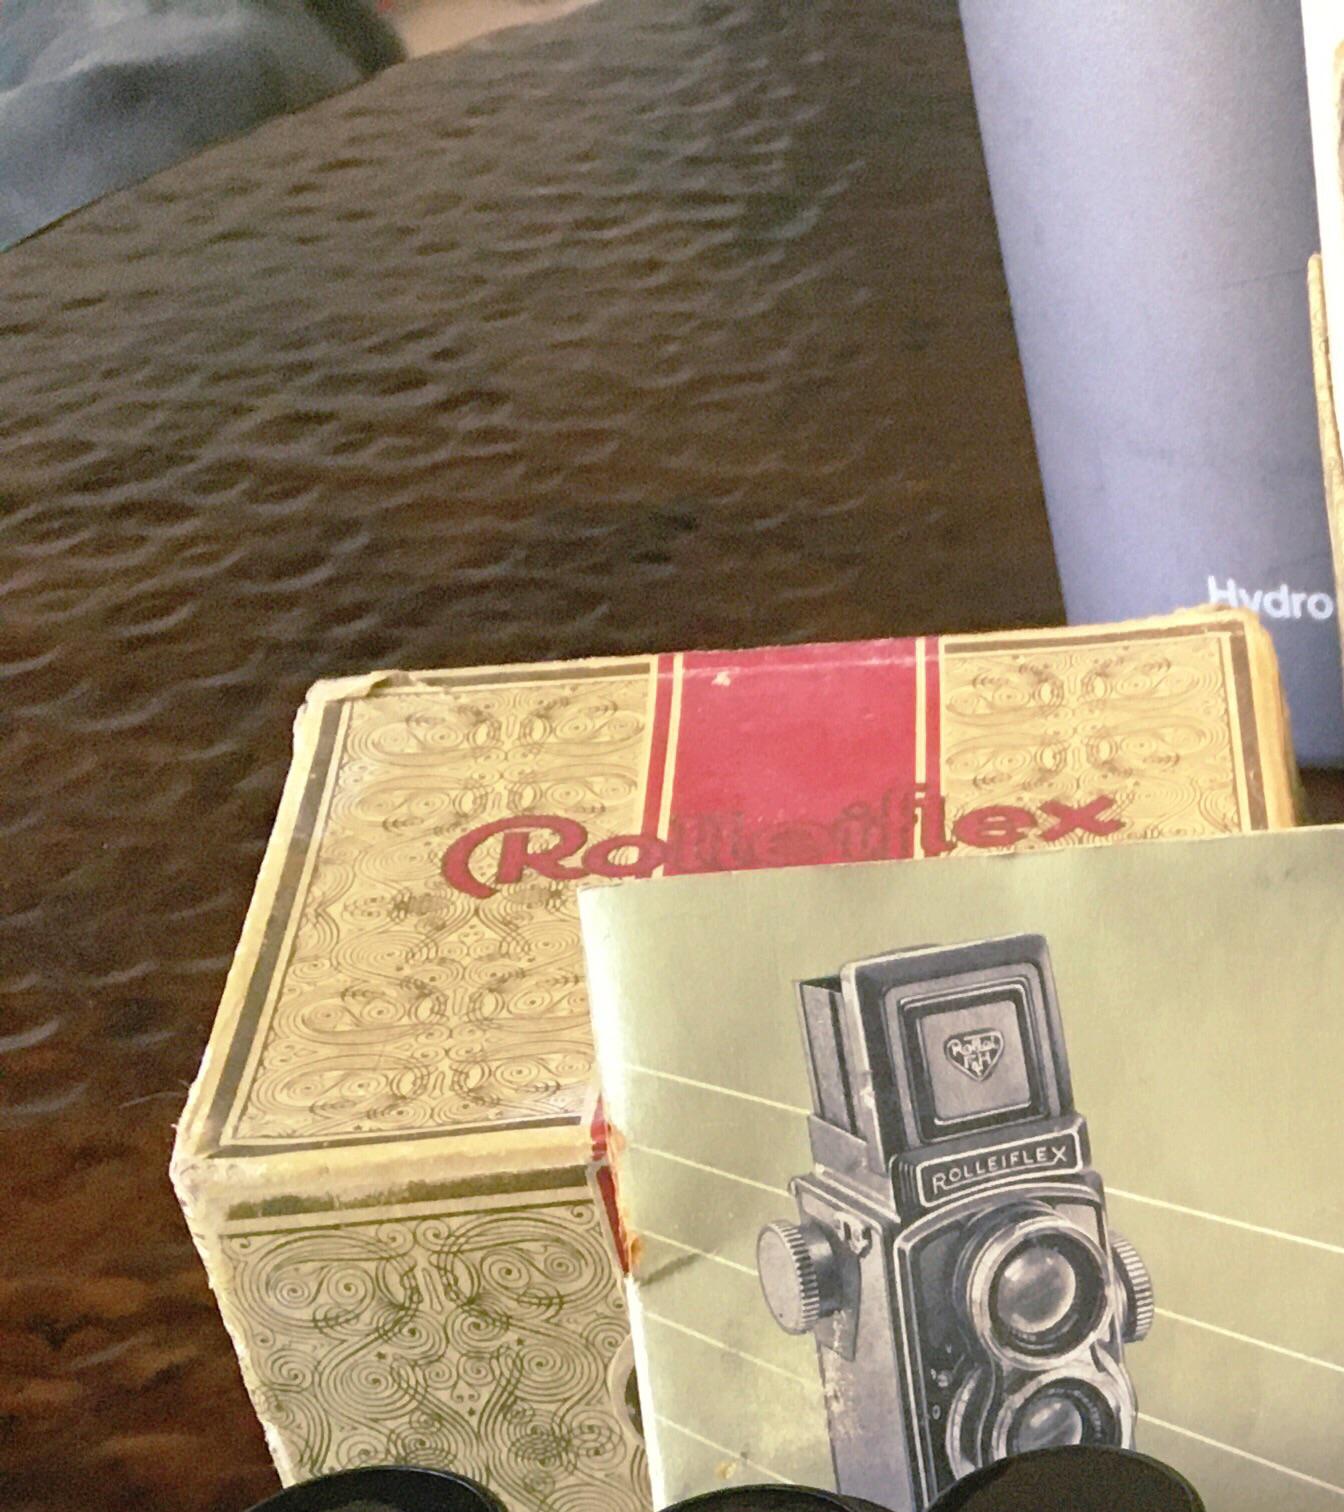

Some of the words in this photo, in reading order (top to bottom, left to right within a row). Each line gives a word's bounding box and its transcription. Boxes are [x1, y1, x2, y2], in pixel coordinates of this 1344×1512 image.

[1207, 575, 1334, 620] Hydro
[441, 783, 1128, 898] Rolleiflex
[931, 1146, 1068, 1196] ROLLEIFLEX
